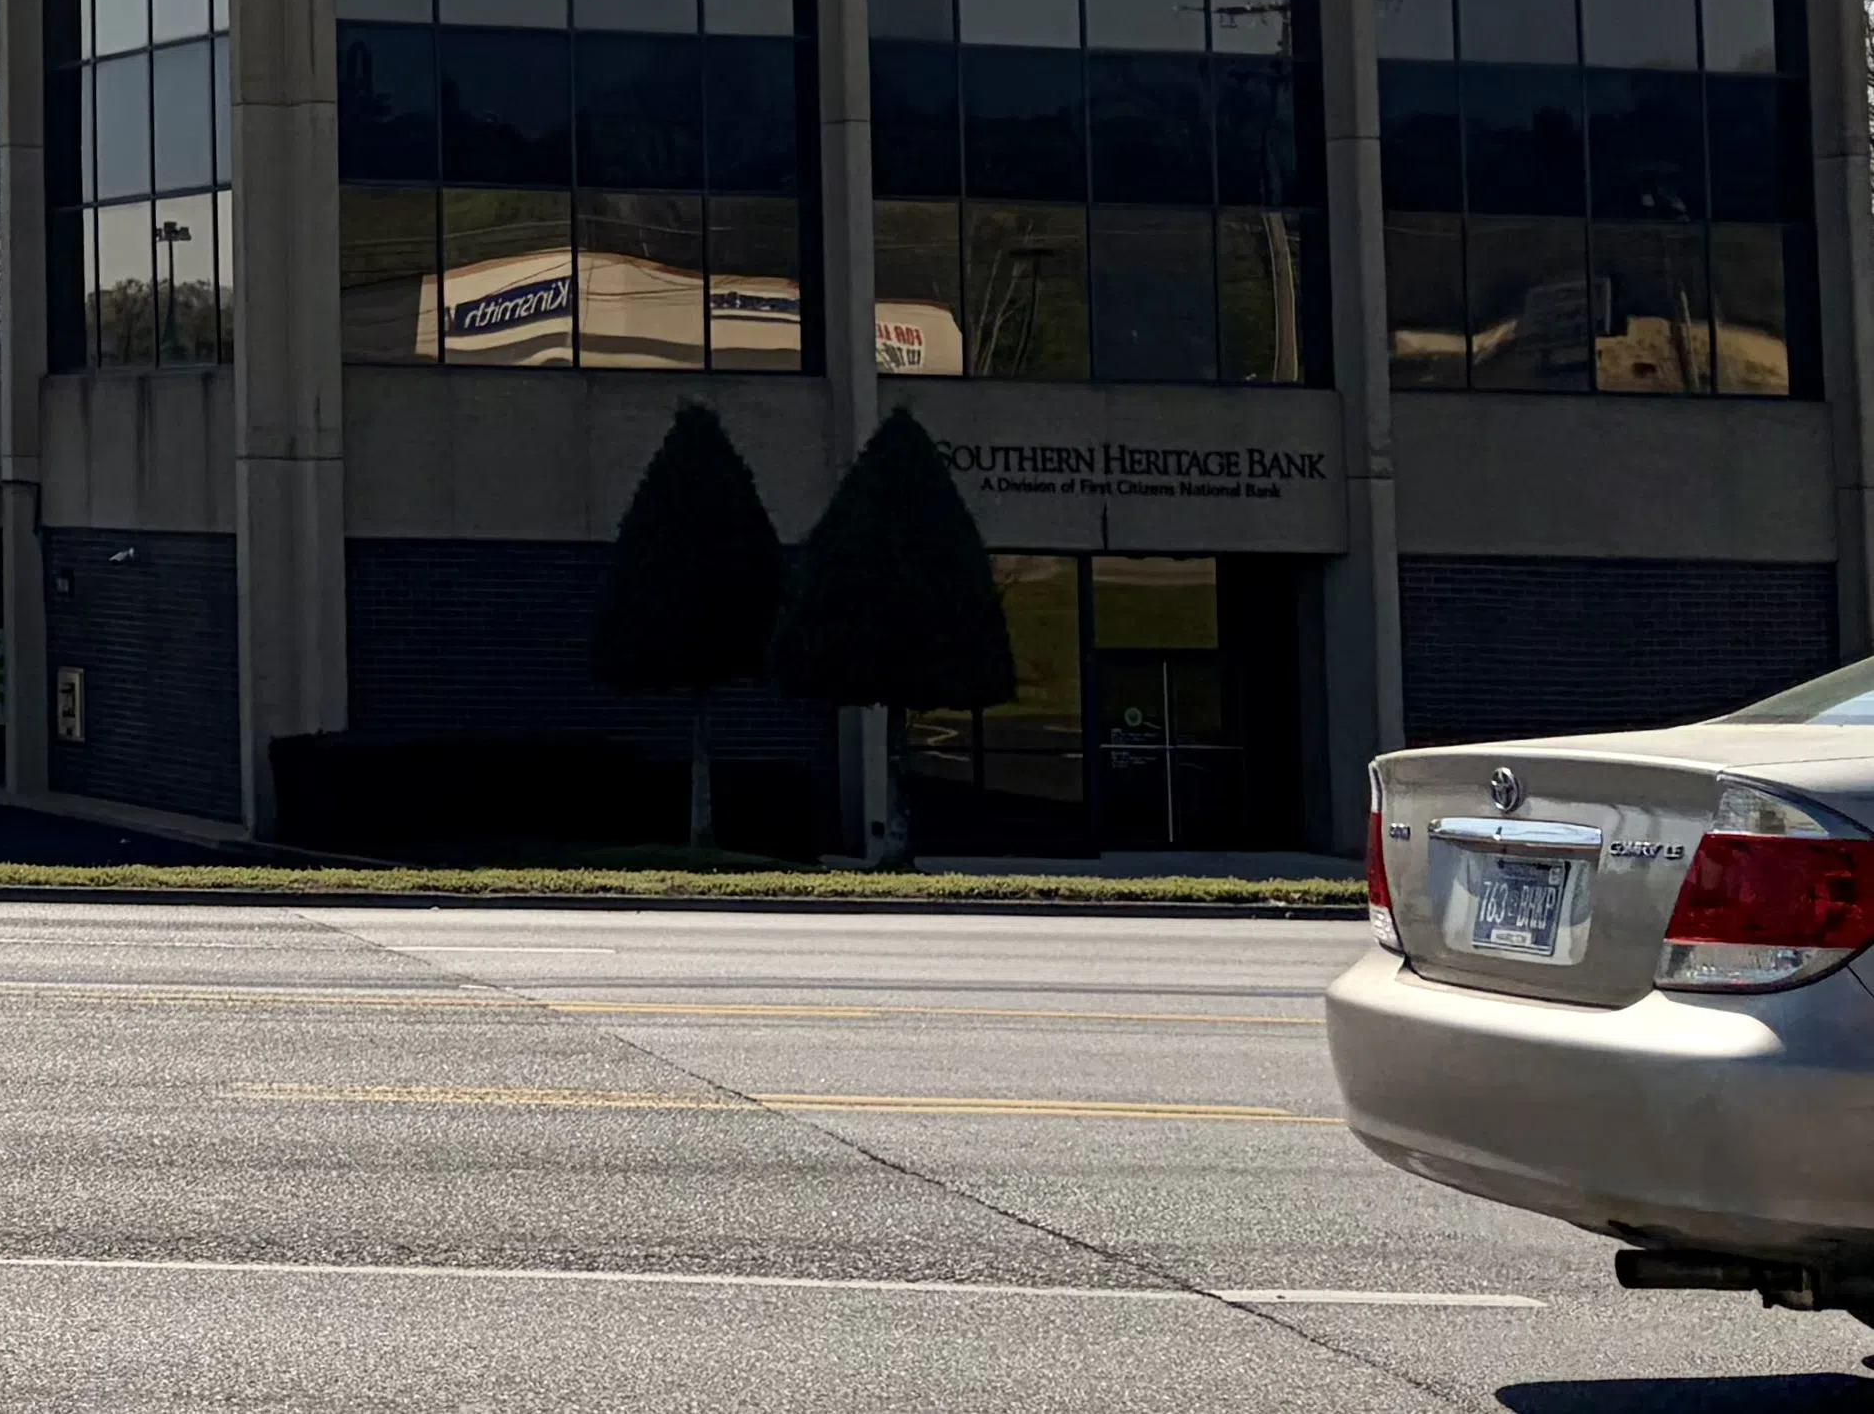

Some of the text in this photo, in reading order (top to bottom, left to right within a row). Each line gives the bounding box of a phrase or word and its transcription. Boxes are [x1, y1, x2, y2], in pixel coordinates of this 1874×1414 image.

[936, 441, 1327, 480] SOUTHERN HERITAGE BANK
[981, 477, 1282, 499] A Division of First Citizens National Bank
